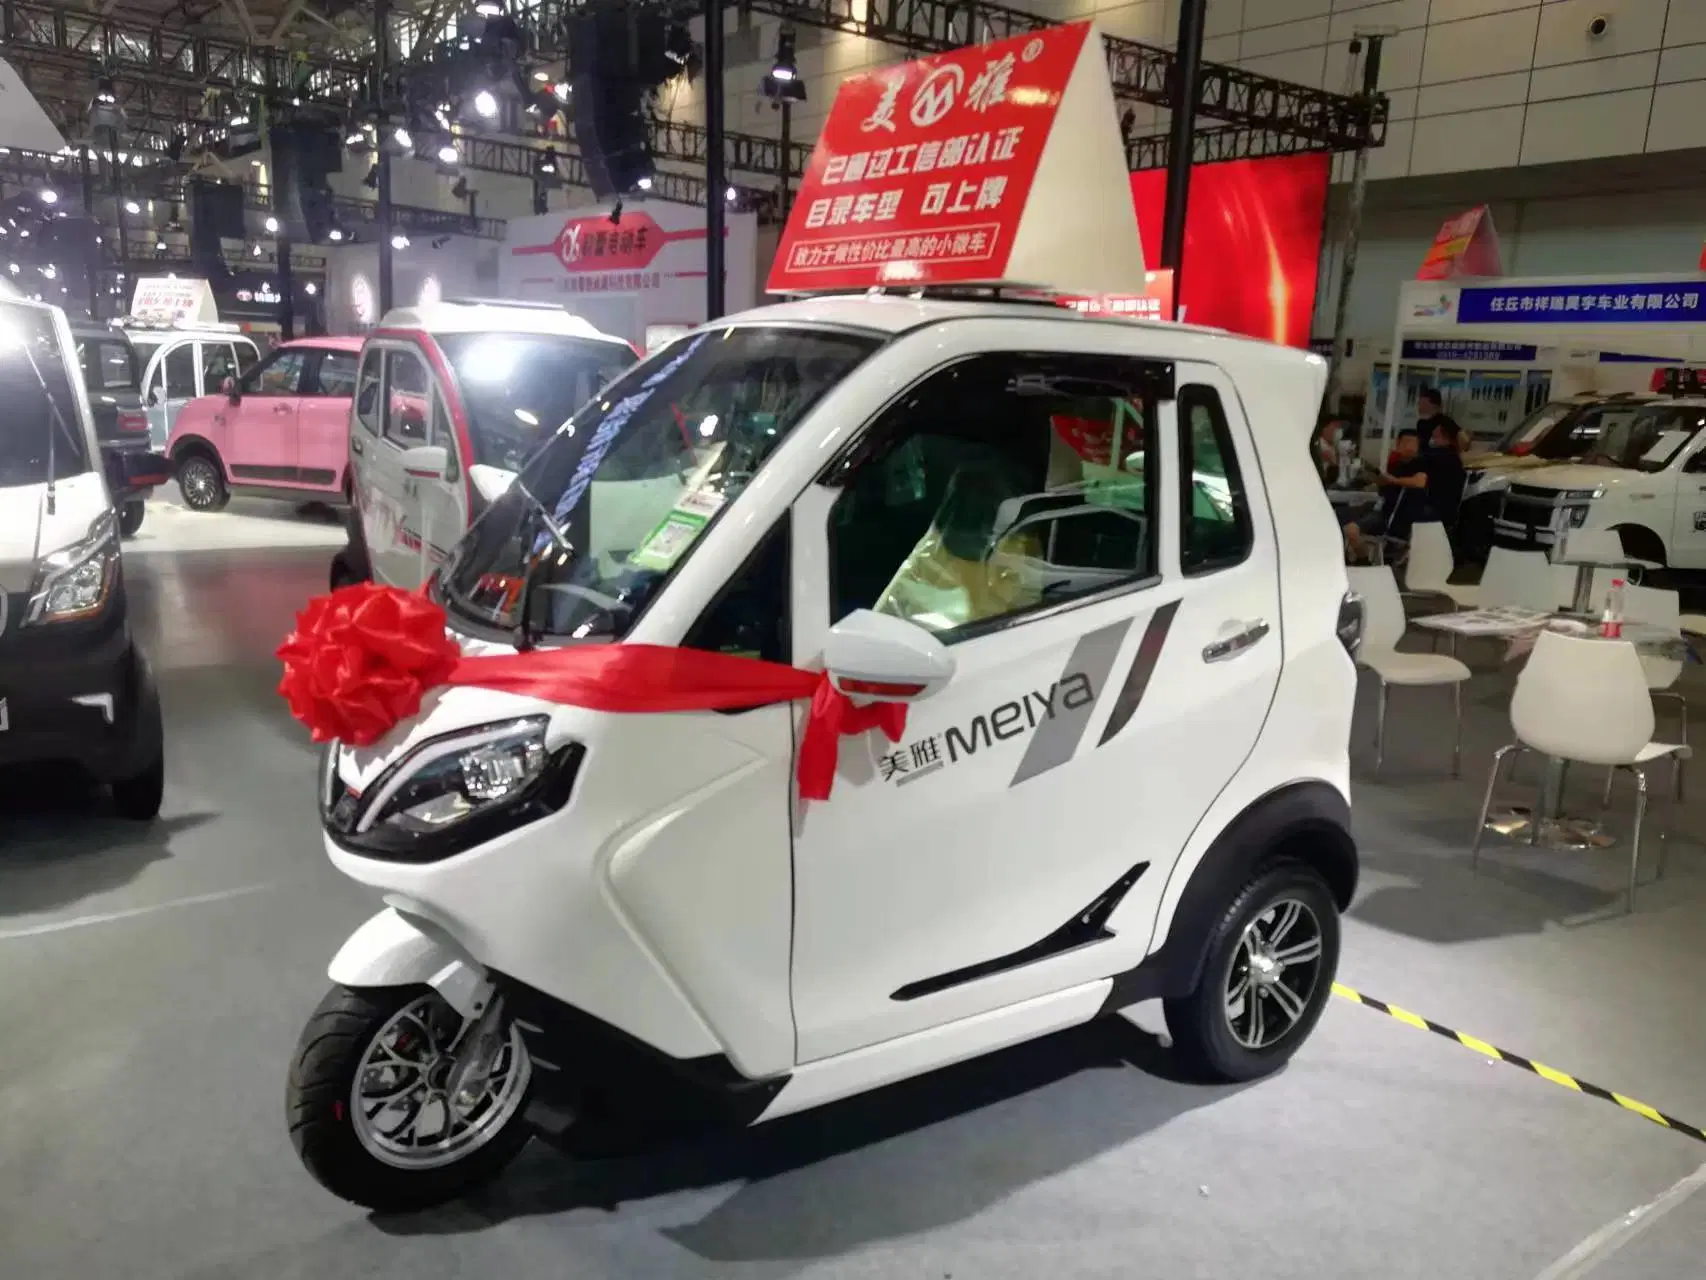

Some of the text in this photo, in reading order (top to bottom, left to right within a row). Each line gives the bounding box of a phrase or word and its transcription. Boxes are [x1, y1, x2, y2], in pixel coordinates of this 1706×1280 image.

[805, 176, 1008, 229] 目录车型 可上牌
